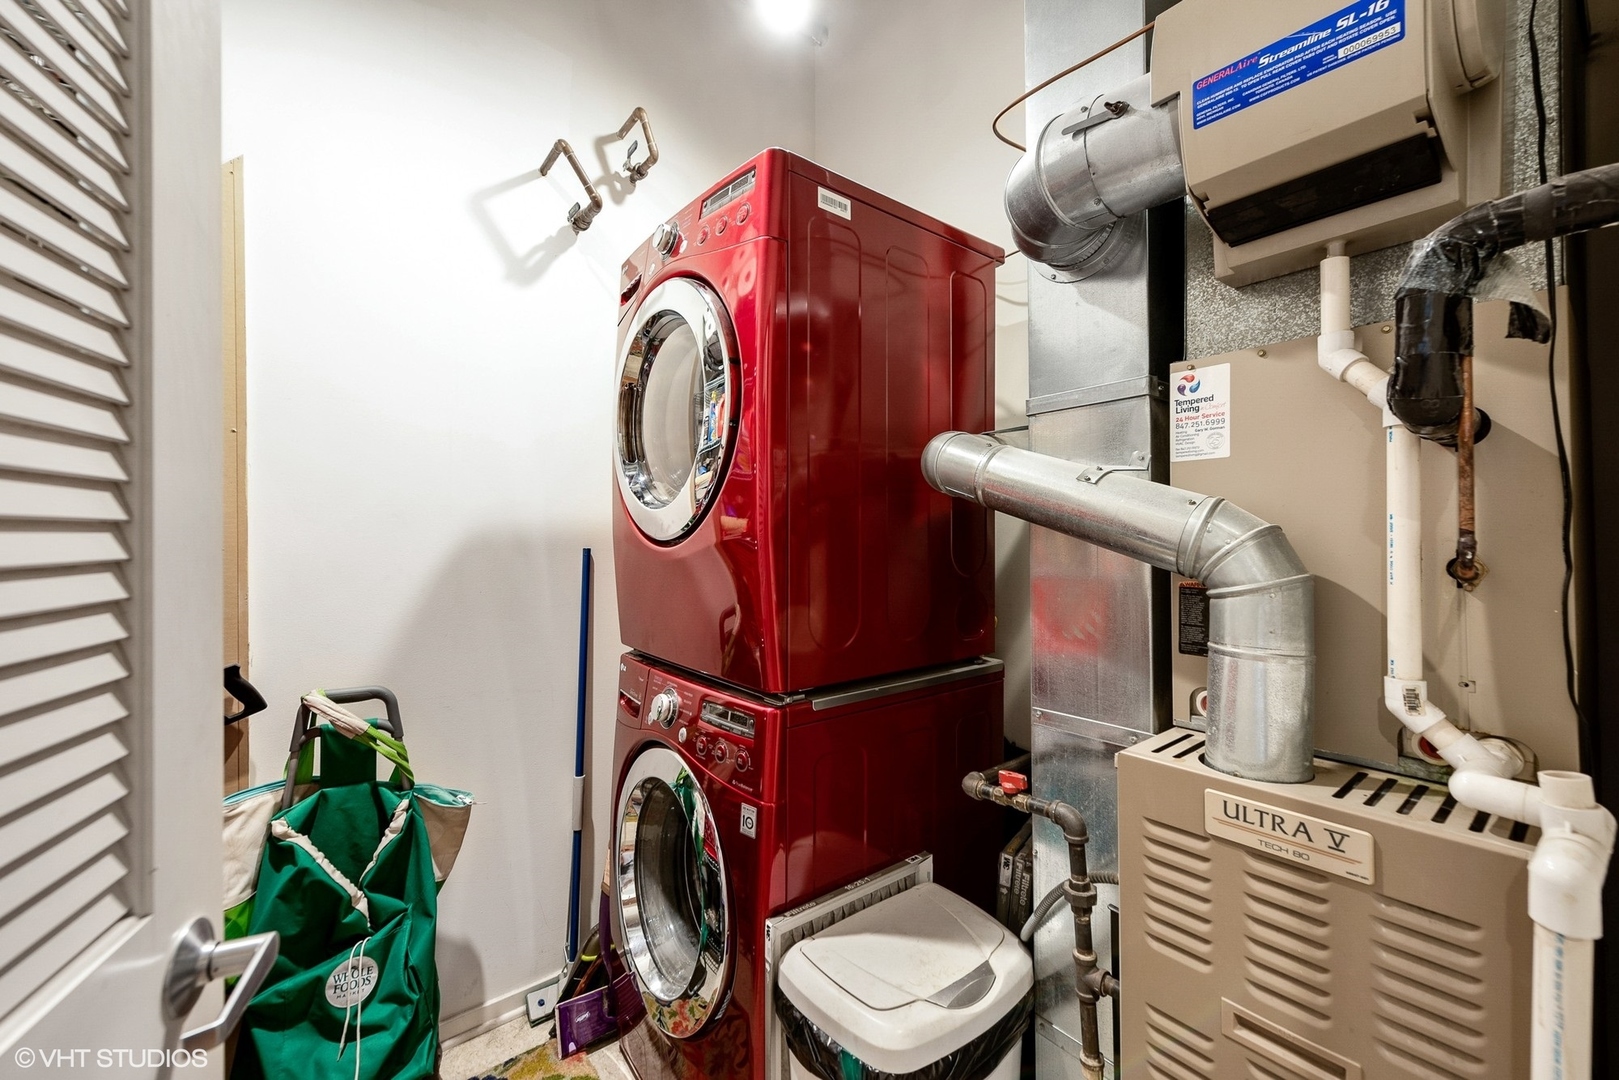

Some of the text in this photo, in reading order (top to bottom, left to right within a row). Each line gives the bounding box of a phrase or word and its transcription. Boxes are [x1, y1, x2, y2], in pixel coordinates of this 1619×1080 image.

[1258, 28, 1332, 69] Streamline
[1335, 0, 1390, 32] SL-16
[1343, 26, 1397, 55] 000069953
[1174, 394, 1214, 406] Tempered
[1176, 405, 1200, 414] Living
[1175, 417, 1226, 429] 847.251.6999
[1201, 411, 1226, 419] Service
[1223, 800, 1350, 854] ULTRA V
[1257, 838, 1310, 862] TECH 80
[1013, 862, 1023, 895] Filtrete
[1019, 872, 1030, 906] Filtrete
